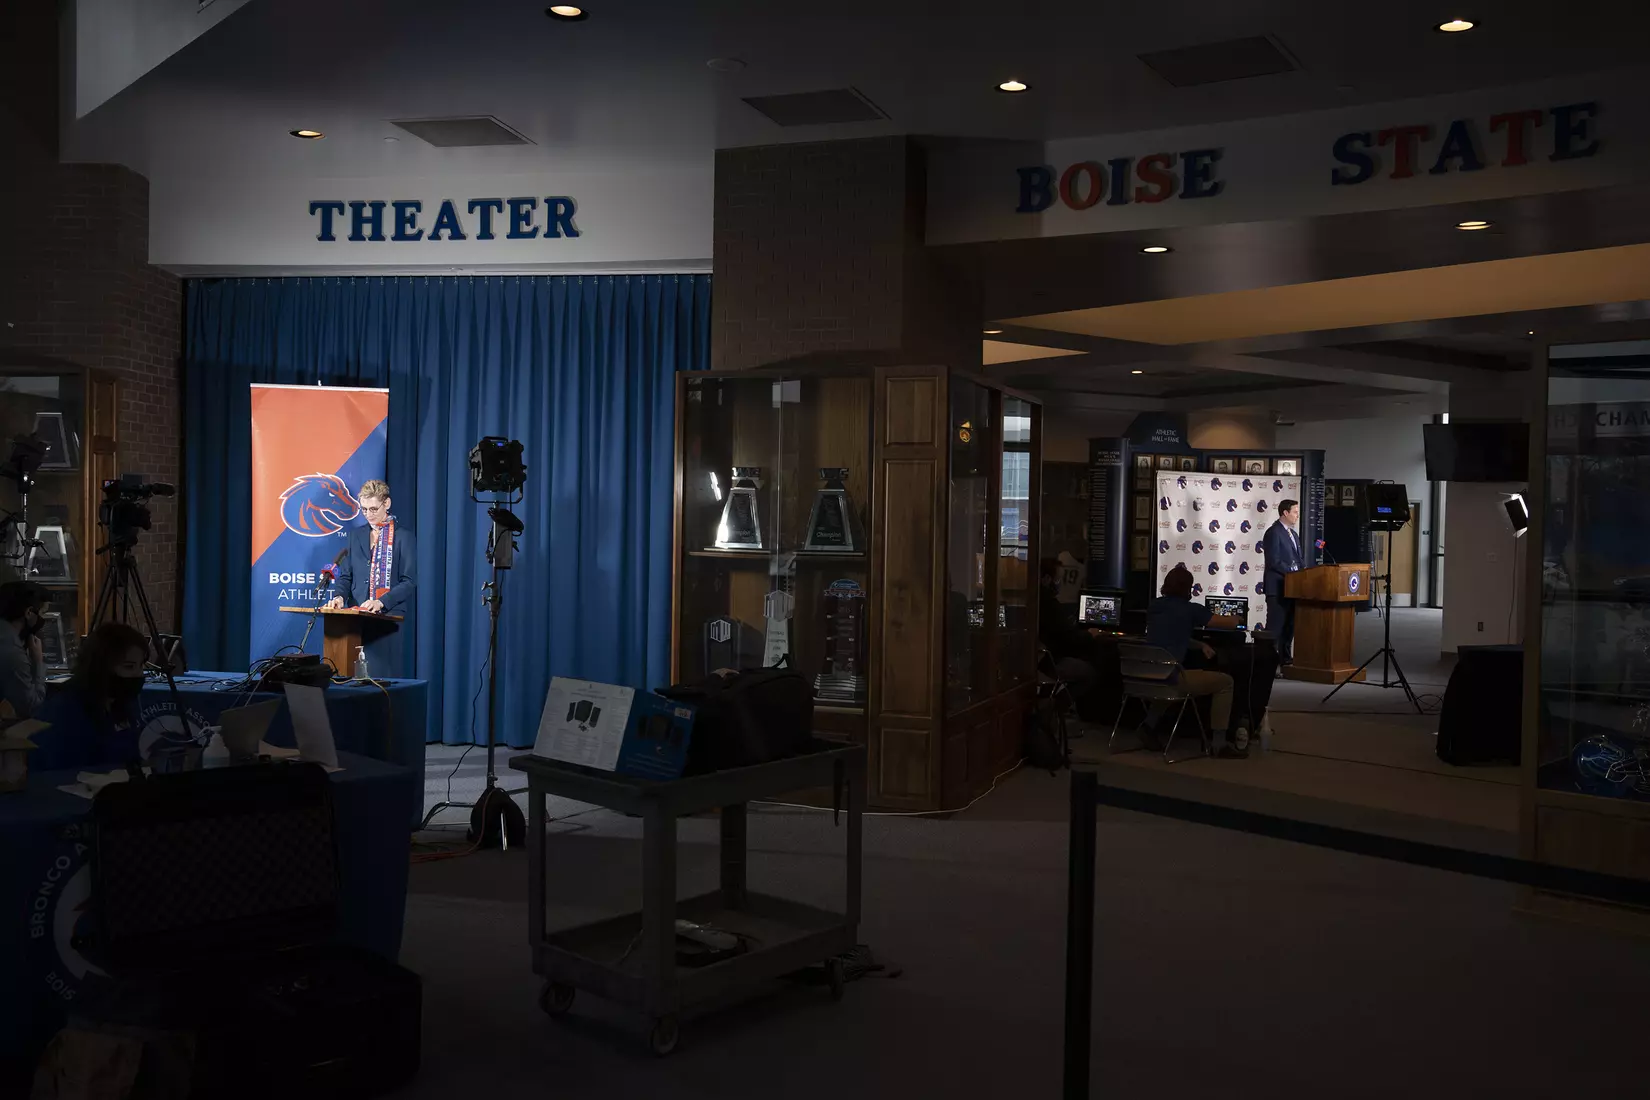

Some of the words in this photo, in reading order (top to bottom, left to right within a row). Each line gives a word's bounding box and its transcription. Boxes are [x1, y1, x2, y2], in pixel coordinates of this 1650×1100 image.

[1016, 149, 1222, 212] BOISE
[1332, 102, 1600, 185] STATE
[309, 197, 580, 241] THEATER
[269, 573, 315, 584] BOISE
[30, 855, 71, 939] BRONCO
